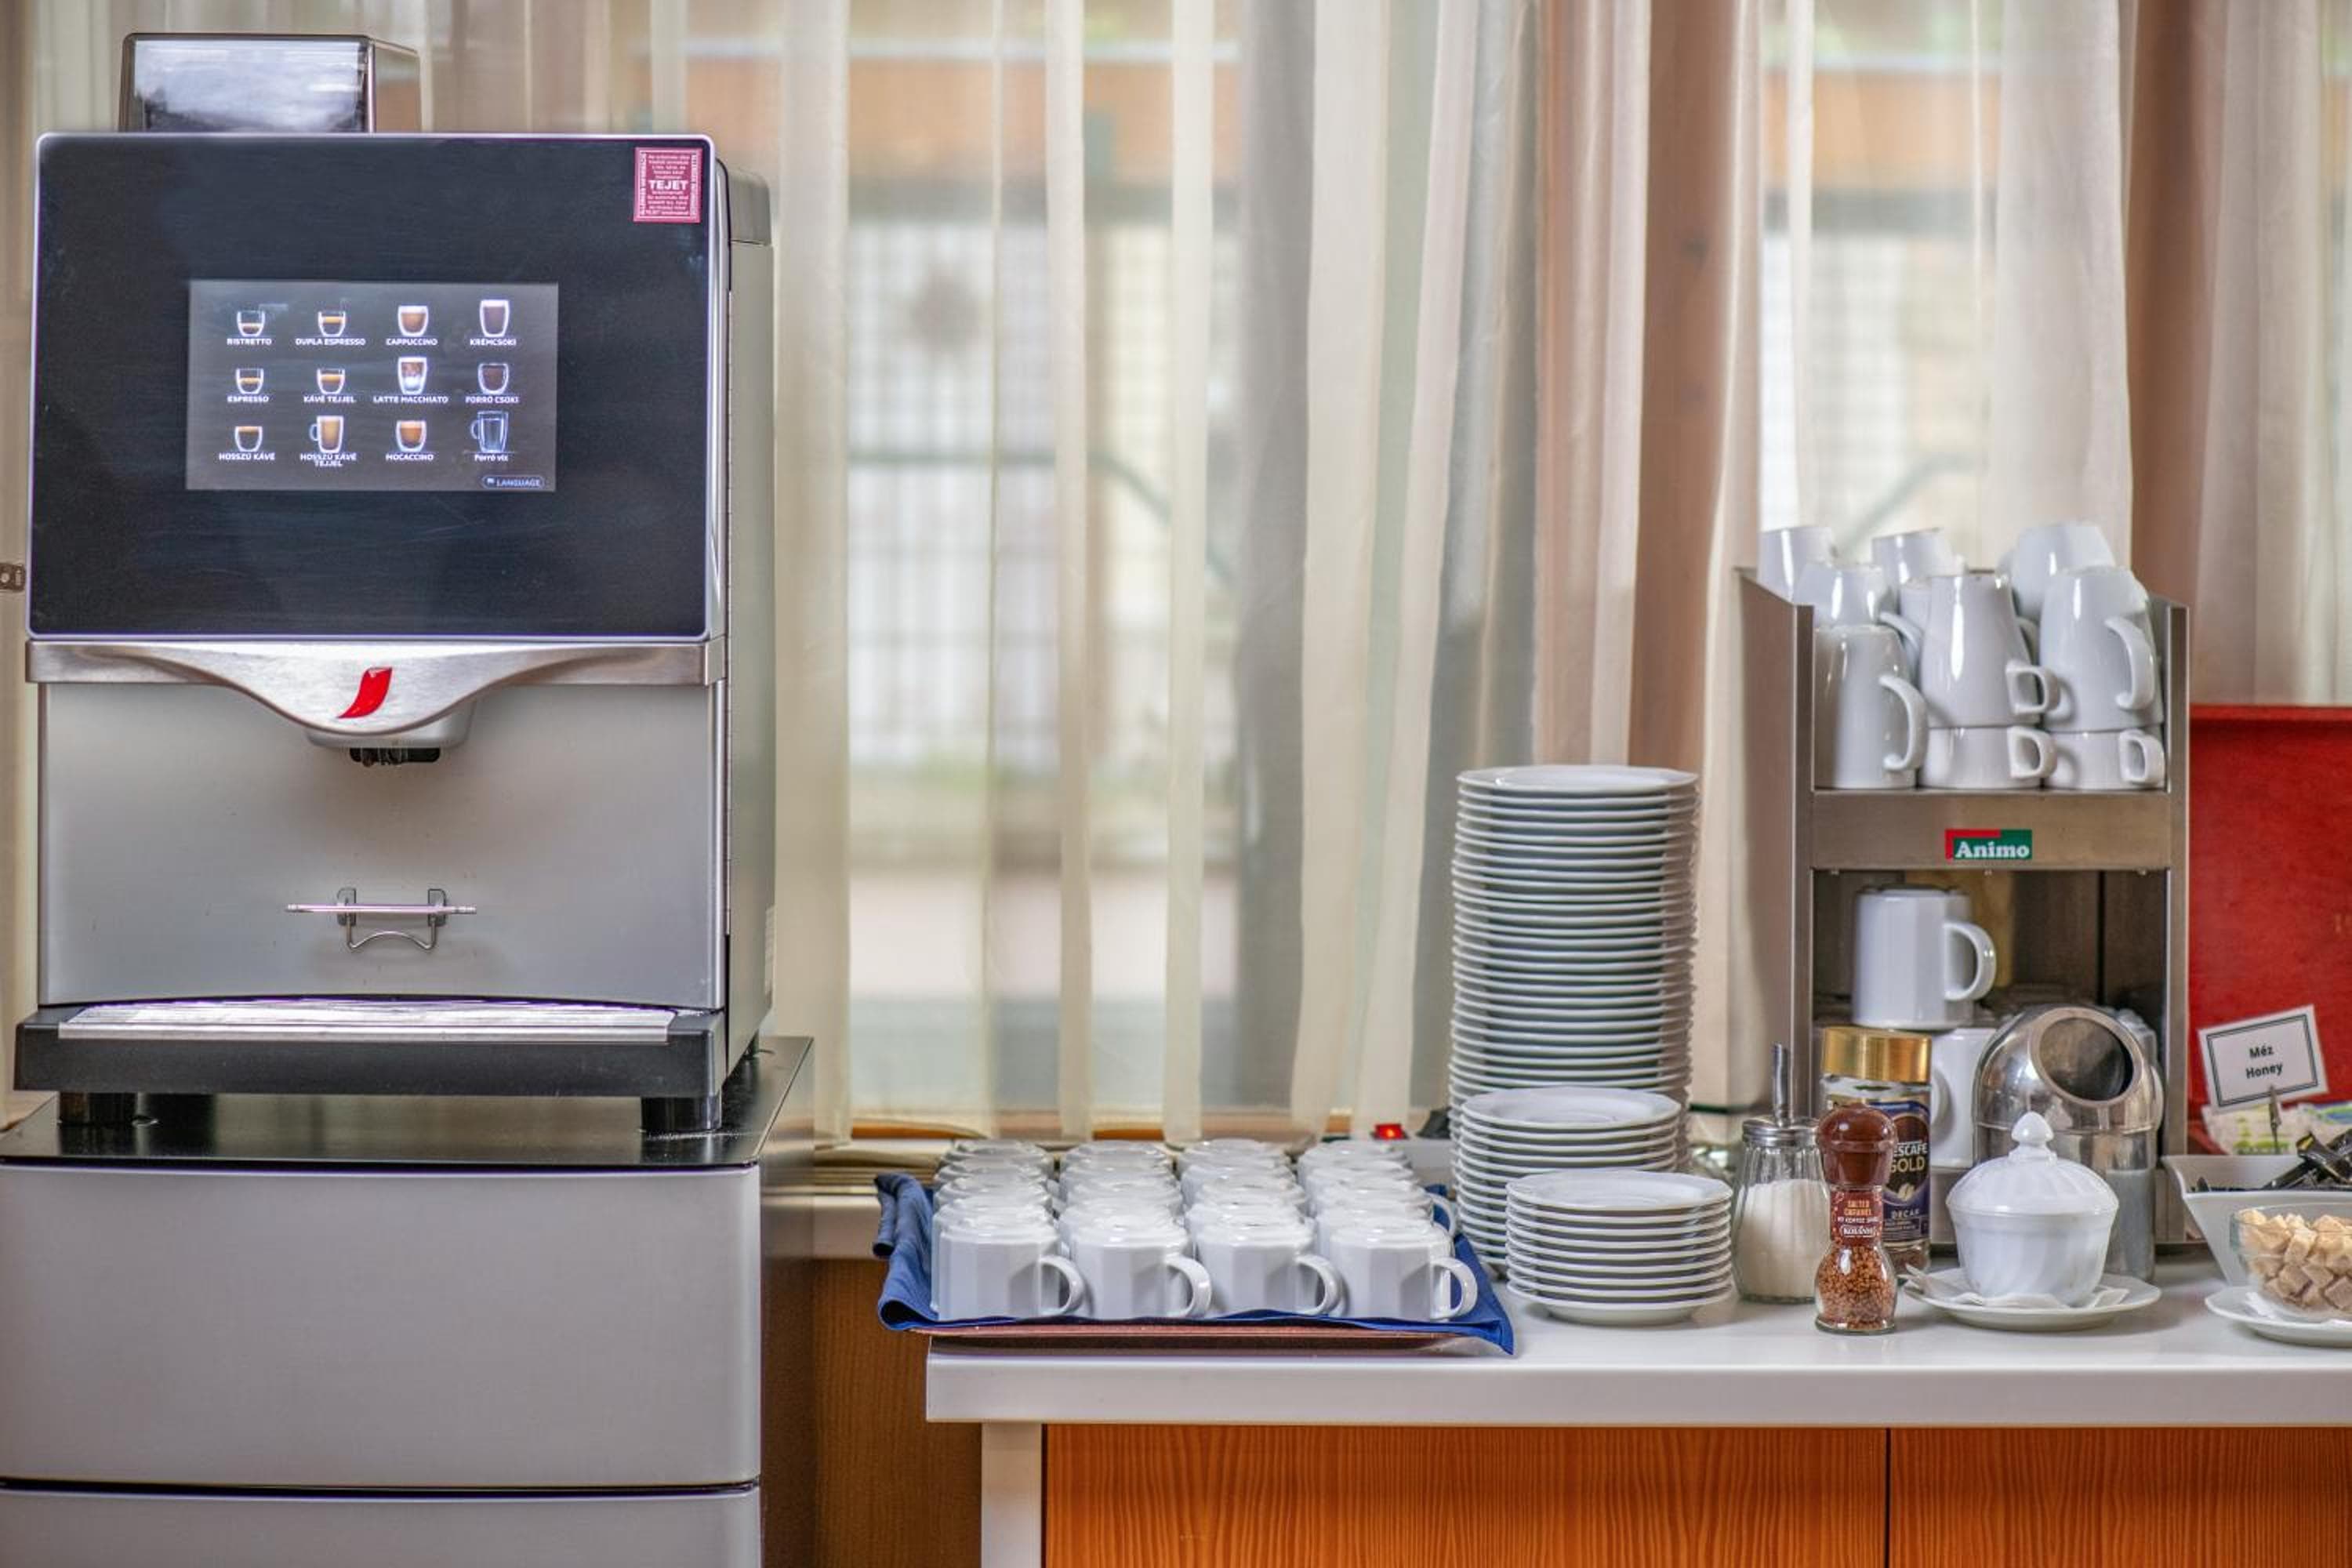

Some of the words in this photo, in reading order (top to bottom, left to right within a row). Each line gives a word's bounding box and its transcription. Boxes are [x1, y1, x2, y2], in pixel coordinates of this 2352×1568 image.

[648, 180, 689, 190] TEJET
[303, 394, 325, 403] KÁVÉ
[253, 452, 276, 461] KÁVÉ
[496, 477, 540, 487] LANGUAGE
[1955, 840, 2030, 858] Animo
[2249, 1045, 2274, 1058] Méz
[2246, 1063, 2283, 1079] Honey
